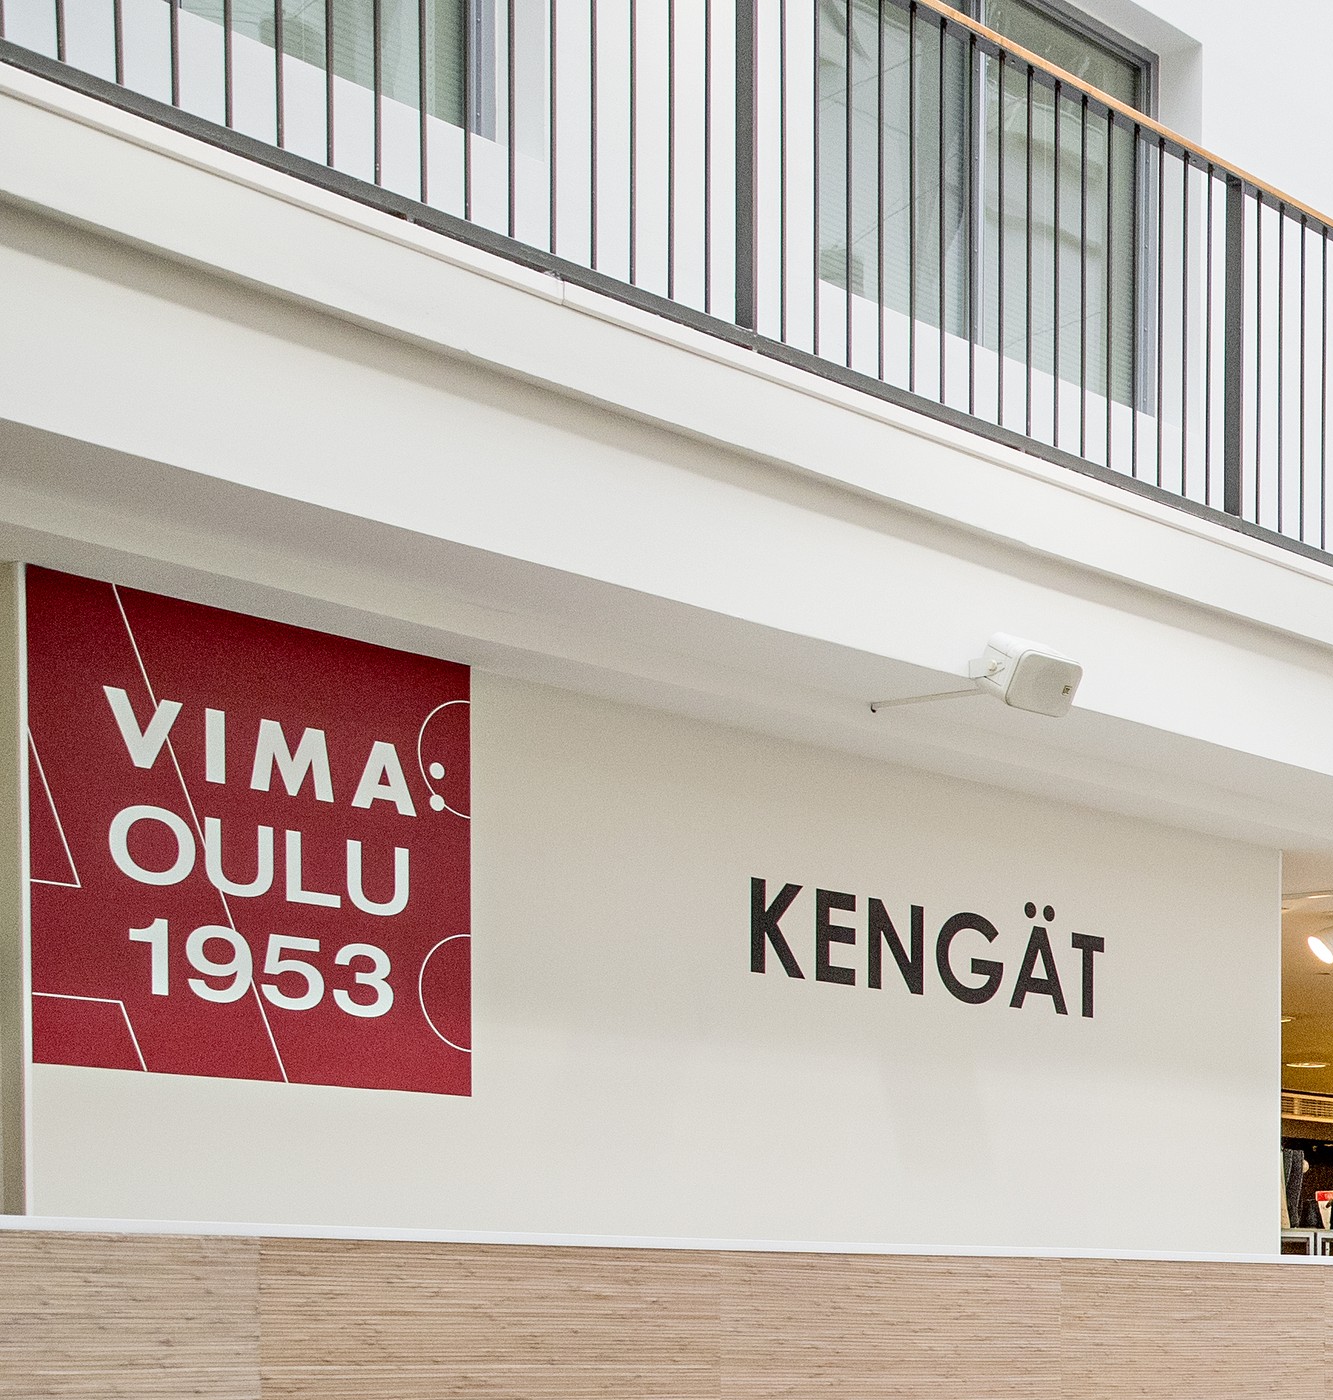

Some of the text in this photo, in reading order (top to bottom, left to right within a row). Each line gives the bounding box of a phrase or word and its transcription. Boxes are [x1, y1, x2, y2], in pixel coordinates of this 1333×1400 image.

[102, 685, 446, 817] VIMA:
[108, 804, 410, 917] OULU
[128, 917, 395, 1018] 1953
[750, 876, 1105, 1019] KENGÄT
